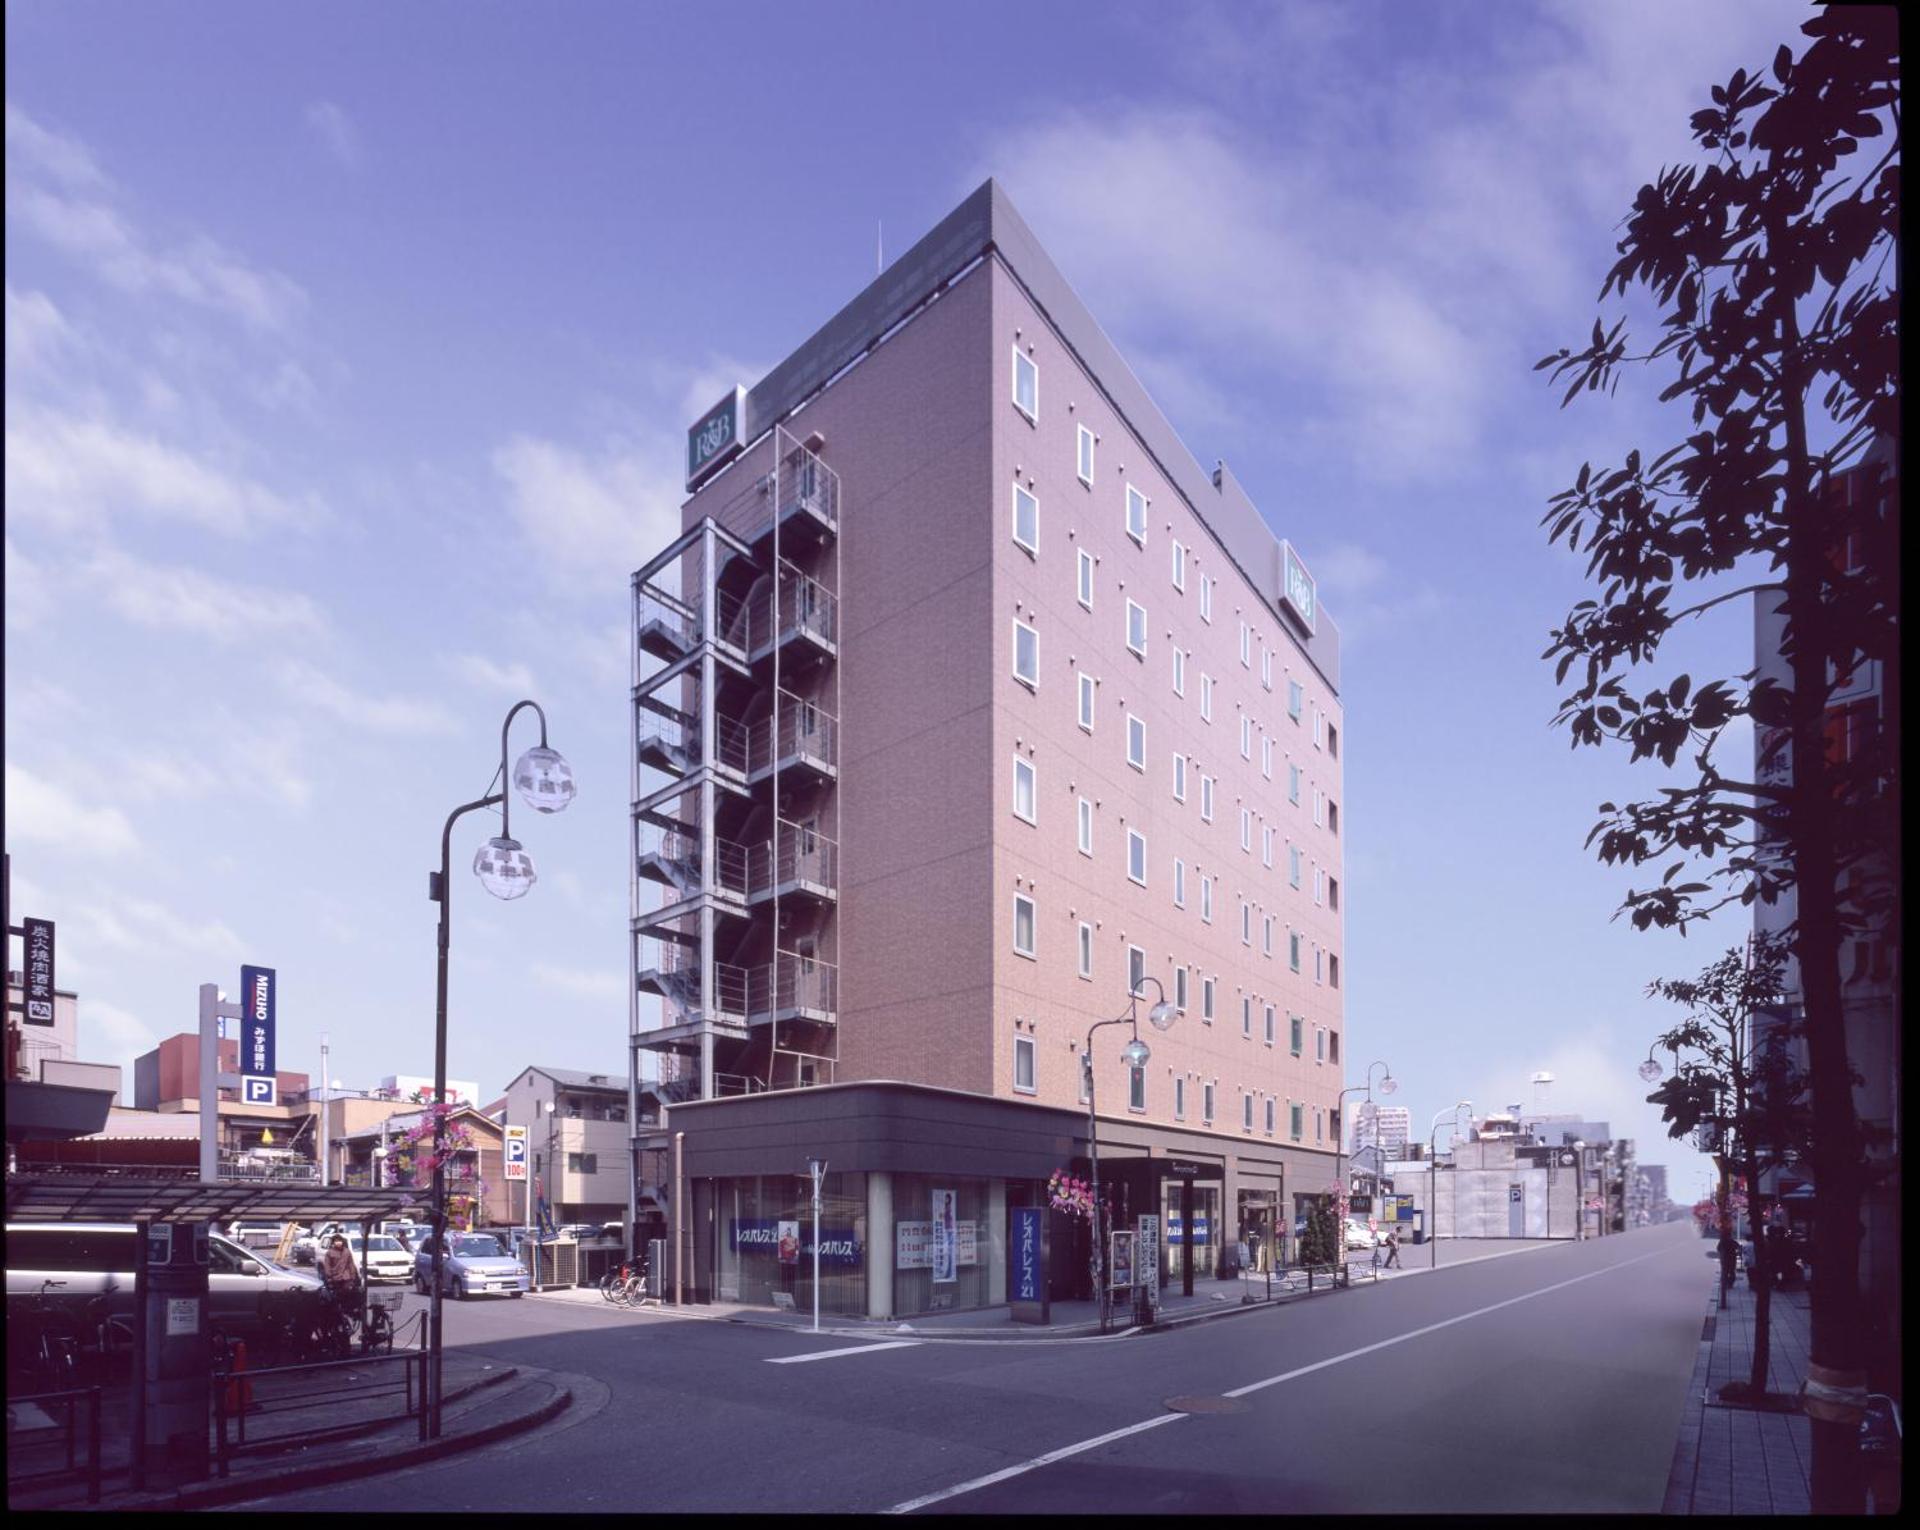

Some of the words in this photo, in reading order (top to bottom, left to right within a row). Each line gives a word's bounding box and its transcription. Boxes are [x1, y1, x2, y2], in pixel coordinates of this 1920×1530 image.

[255, 974, 269, 1021] MIZUHO
[253, 1026, 267, 1071] みずほ銀行
[251, 1081, 269, 1100] P
[509, 1140, 524, 1161] P
[1021, 1211, 1034, 1298] レオパレス21
